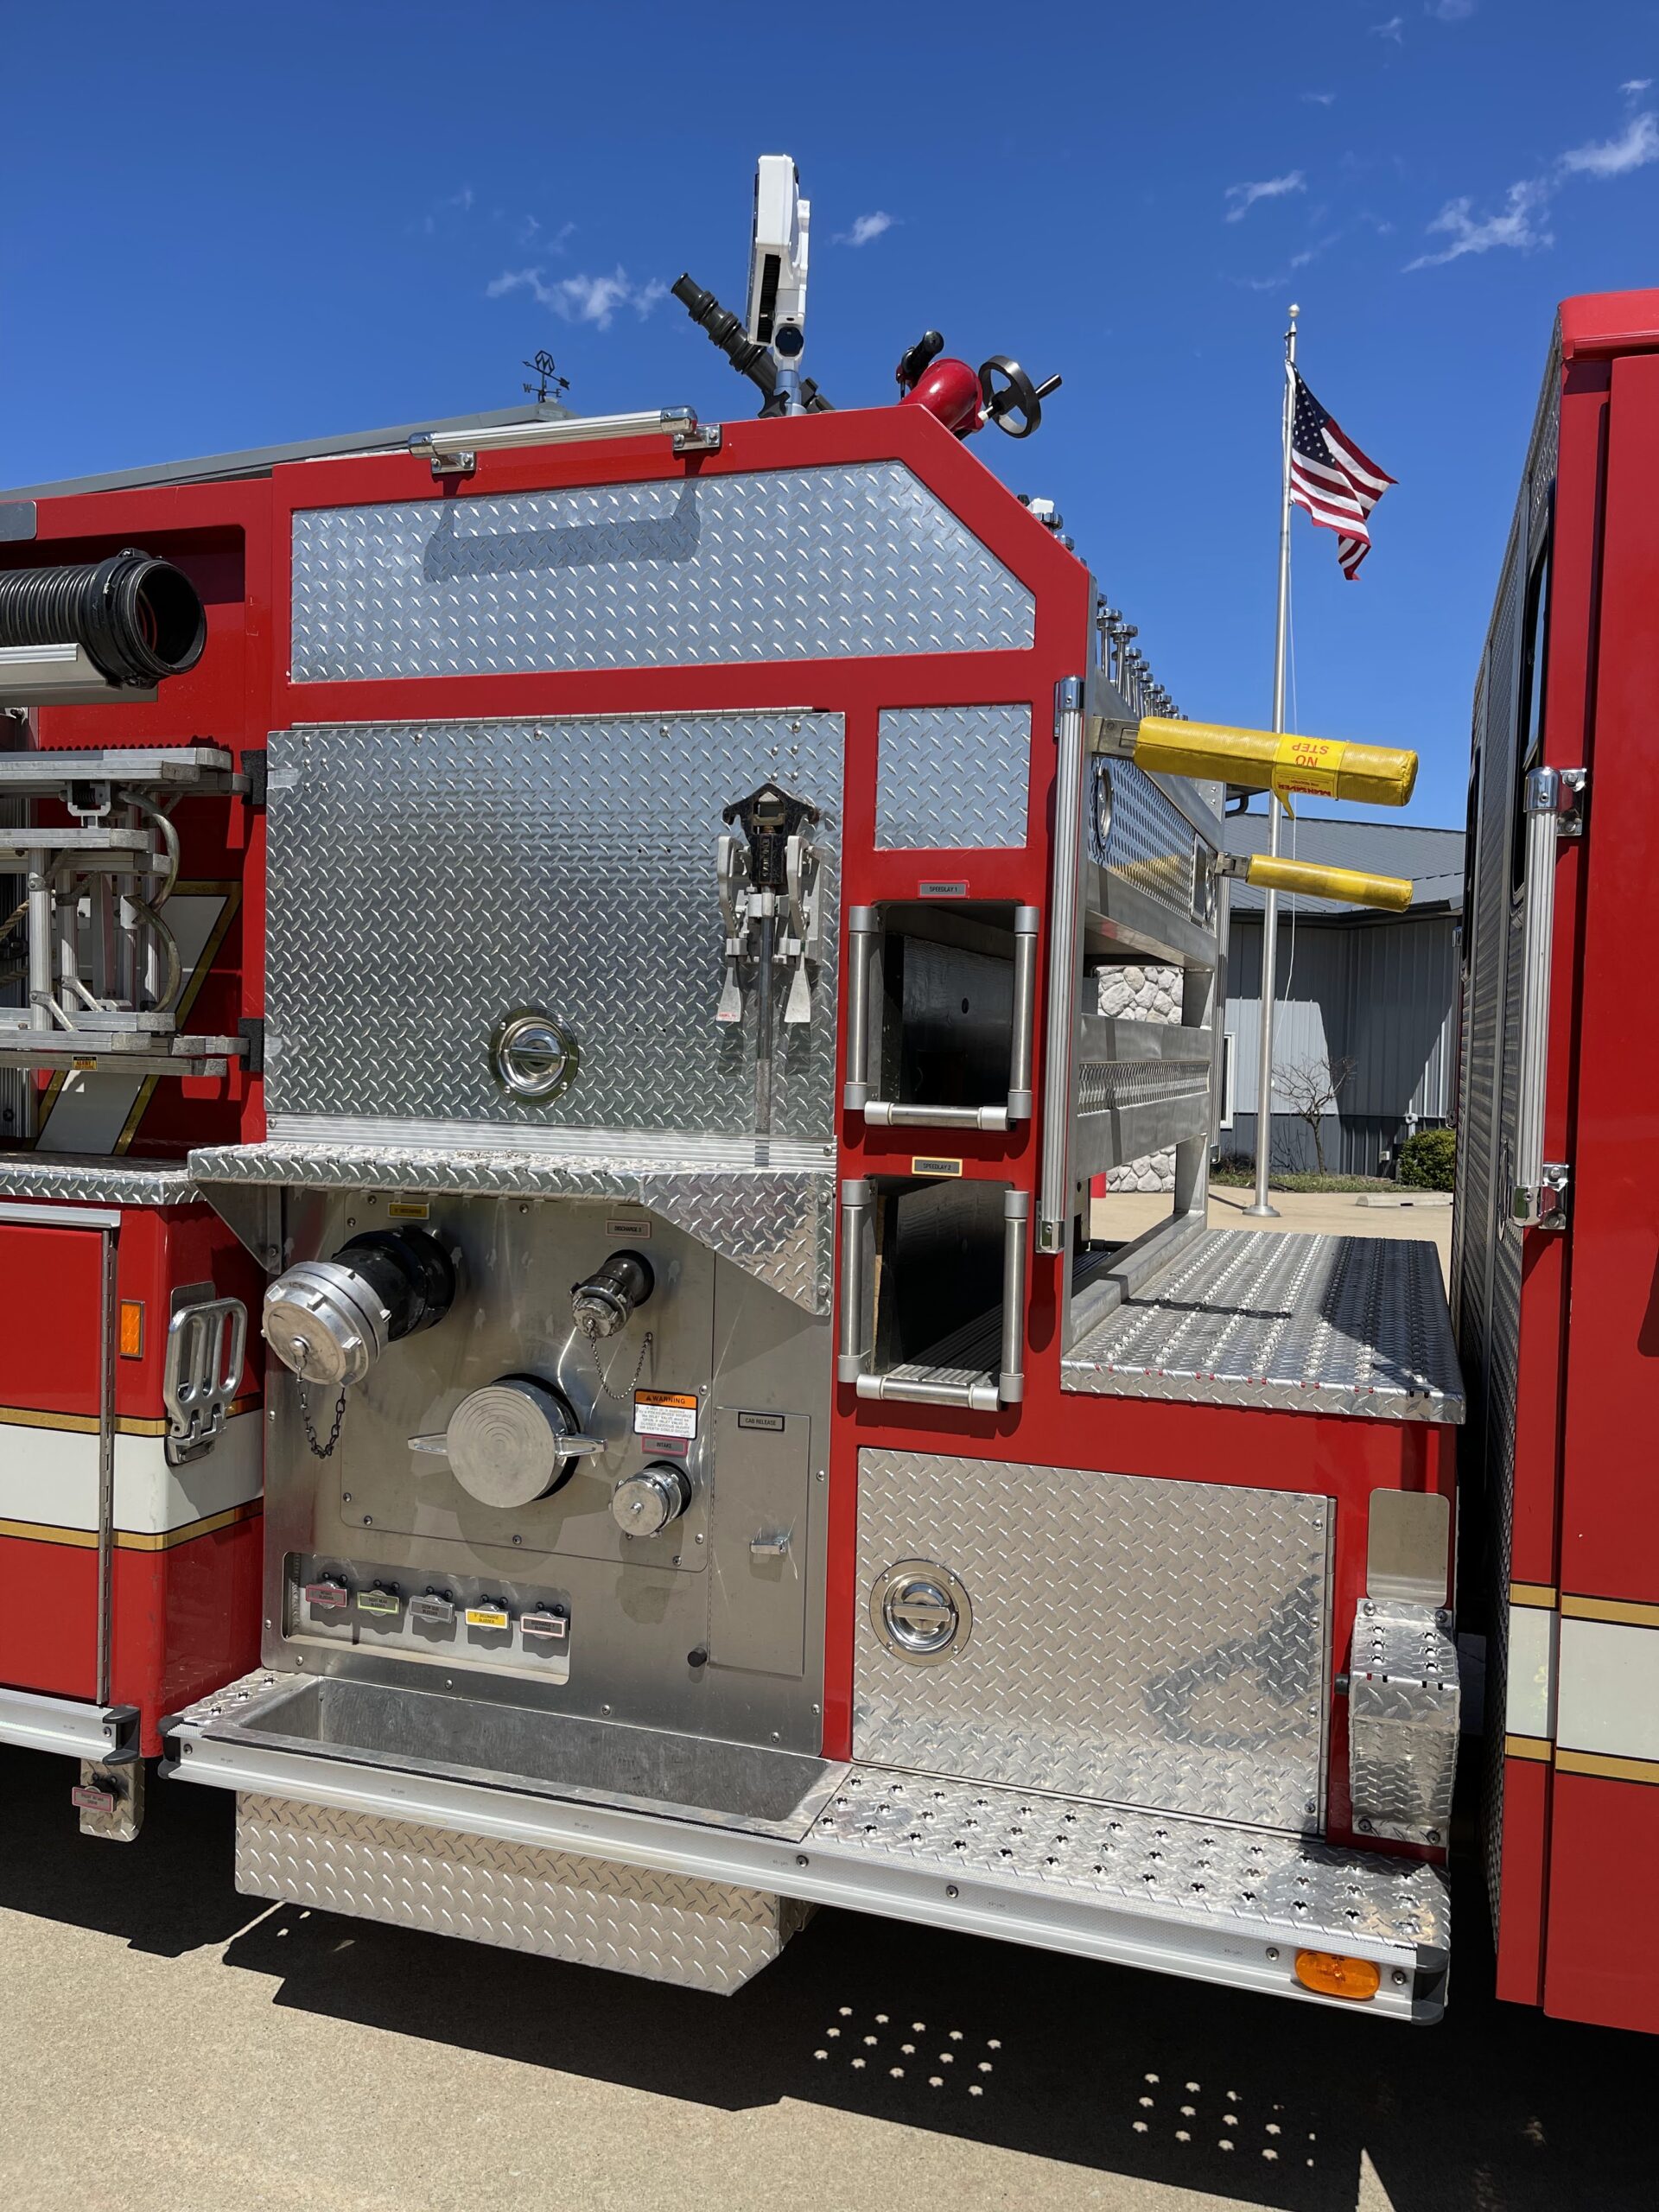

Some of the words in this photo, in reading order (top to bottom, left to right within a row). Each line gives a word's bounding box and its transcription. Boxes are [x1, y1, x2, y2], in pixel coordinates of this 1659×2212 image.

[1292, 742, 1330, 755] STEP
[1295, 754, 1319, 768] NO
[652, 1395, 686, 1405] WARNING
